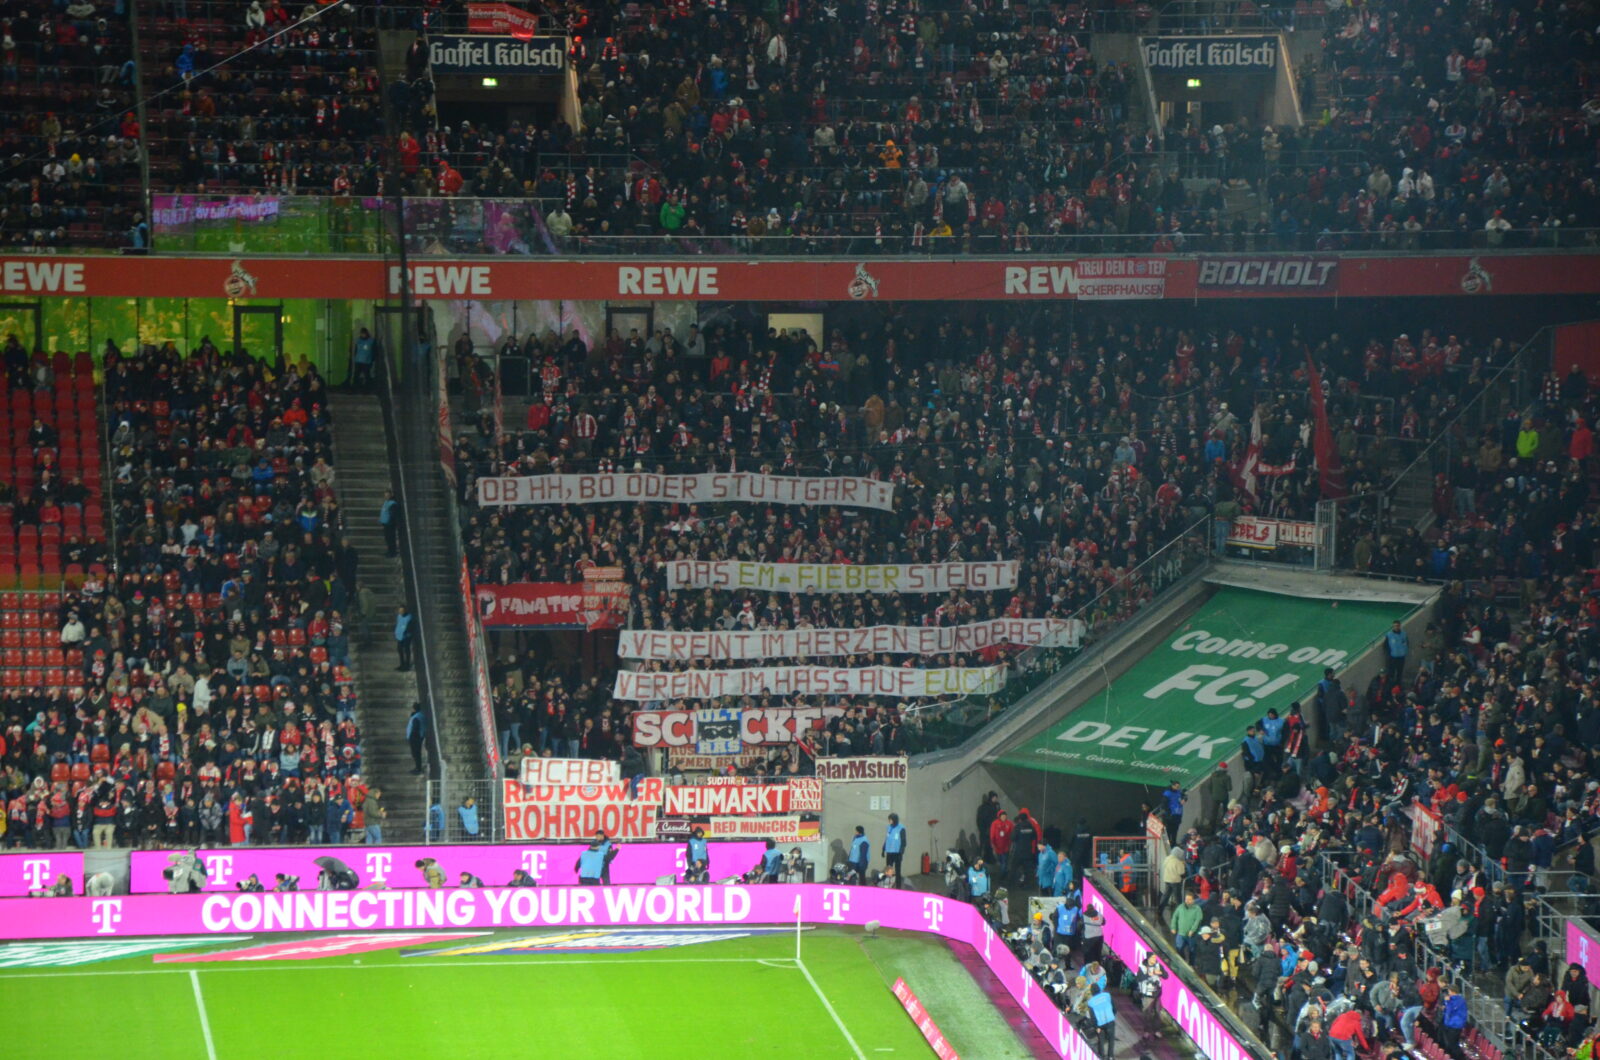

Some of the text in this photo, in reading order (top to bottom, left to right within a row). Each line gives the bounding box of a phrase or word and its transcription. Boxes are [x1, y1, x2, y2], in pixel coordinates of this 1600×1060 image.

[430, 39, 563, 69] Gaffel Kölsch
[1145, 42, 1276, 68] Gaffel Kölsch
[0, 262, 86, 292] EWE
[389, 266, 491, 294] REWE
[618, 267, 719, 295] REWE
[1005, 266, 1077, 295] REW
[1078, 260, 1104, 275] TREU
[1105, 260, 1126, 275] DEN
[1199, 261, 1336, 286] BOCHOLT
[1078, 283, 1164, 296] SCHERFHAUSEN
[483, 479, 518, 502] OB
[626, 475, 698, 498] ODER
[712, 474, 886, 502] STUTTGART:
[675, 562, 729, 585] DAS
[908, 562, 1018, 588] STEIGT!
[762, 633, 785, 657] IM
[796, 627, 908, 656] HERZEN
[1171, 630, 1288, 659] Come
[619, 673, 728, 698] VEREINT
[741, 671, 765, 693] IM
[776, 669, 849, 693] HASS
[860, 670, 914, 694] AUF
[1143, 664, 1300, 709] FC!
[1056, 721, 1234, 759] DEVK
[525, 759, 613, 783] ACAB!
[791, 779, 821, 790] SEEN
[817, 760, 907, 780] alarMstufe
[665, 786, 789, 814] NEUMARKT
[791, 790, 821, 800] LAND
[505, 804, 656, 839] ROHRDORF
[713, 821, 738, 834] RED
[24, 860, 50, 890] T
[207, 855, 233, 885] T
[366, 853, 392, 882] T
[522, 850, 547, 879] T
[92, 900, 121, 933] T
[201, 887, 751, 932] CONNECTING YOUR WORLD
[824, 888, 850, 921] T
[923, 897, 943, 931] T
